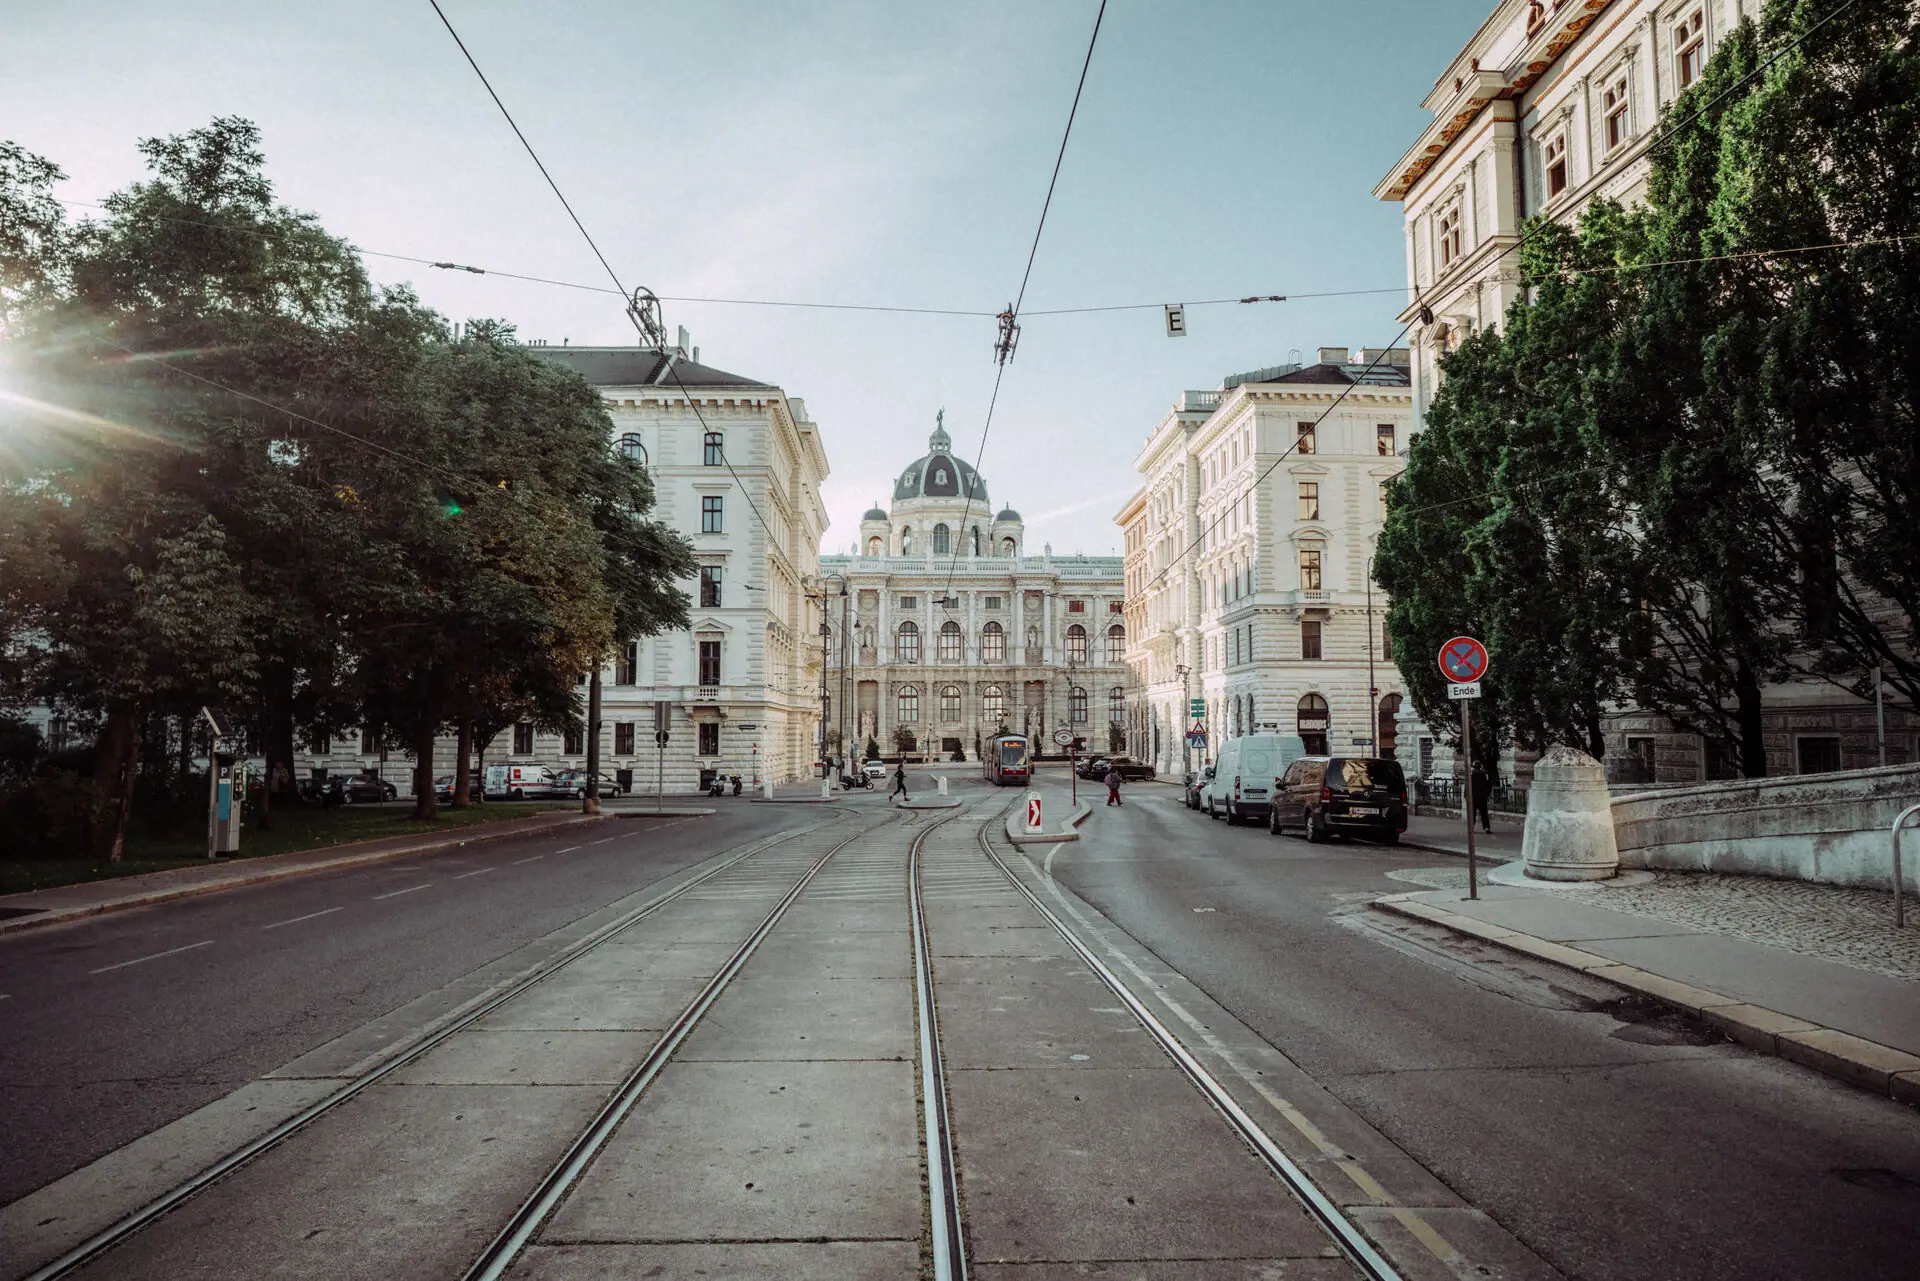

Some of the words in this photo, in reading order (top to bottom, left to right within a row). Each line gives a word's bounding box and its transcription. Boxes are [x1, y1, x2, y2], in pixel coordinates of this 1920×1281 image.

[1169, 311, 1182, 331] E
[1453, 686, 1475, 696] Ende
[221, 767, 228, 776] P
